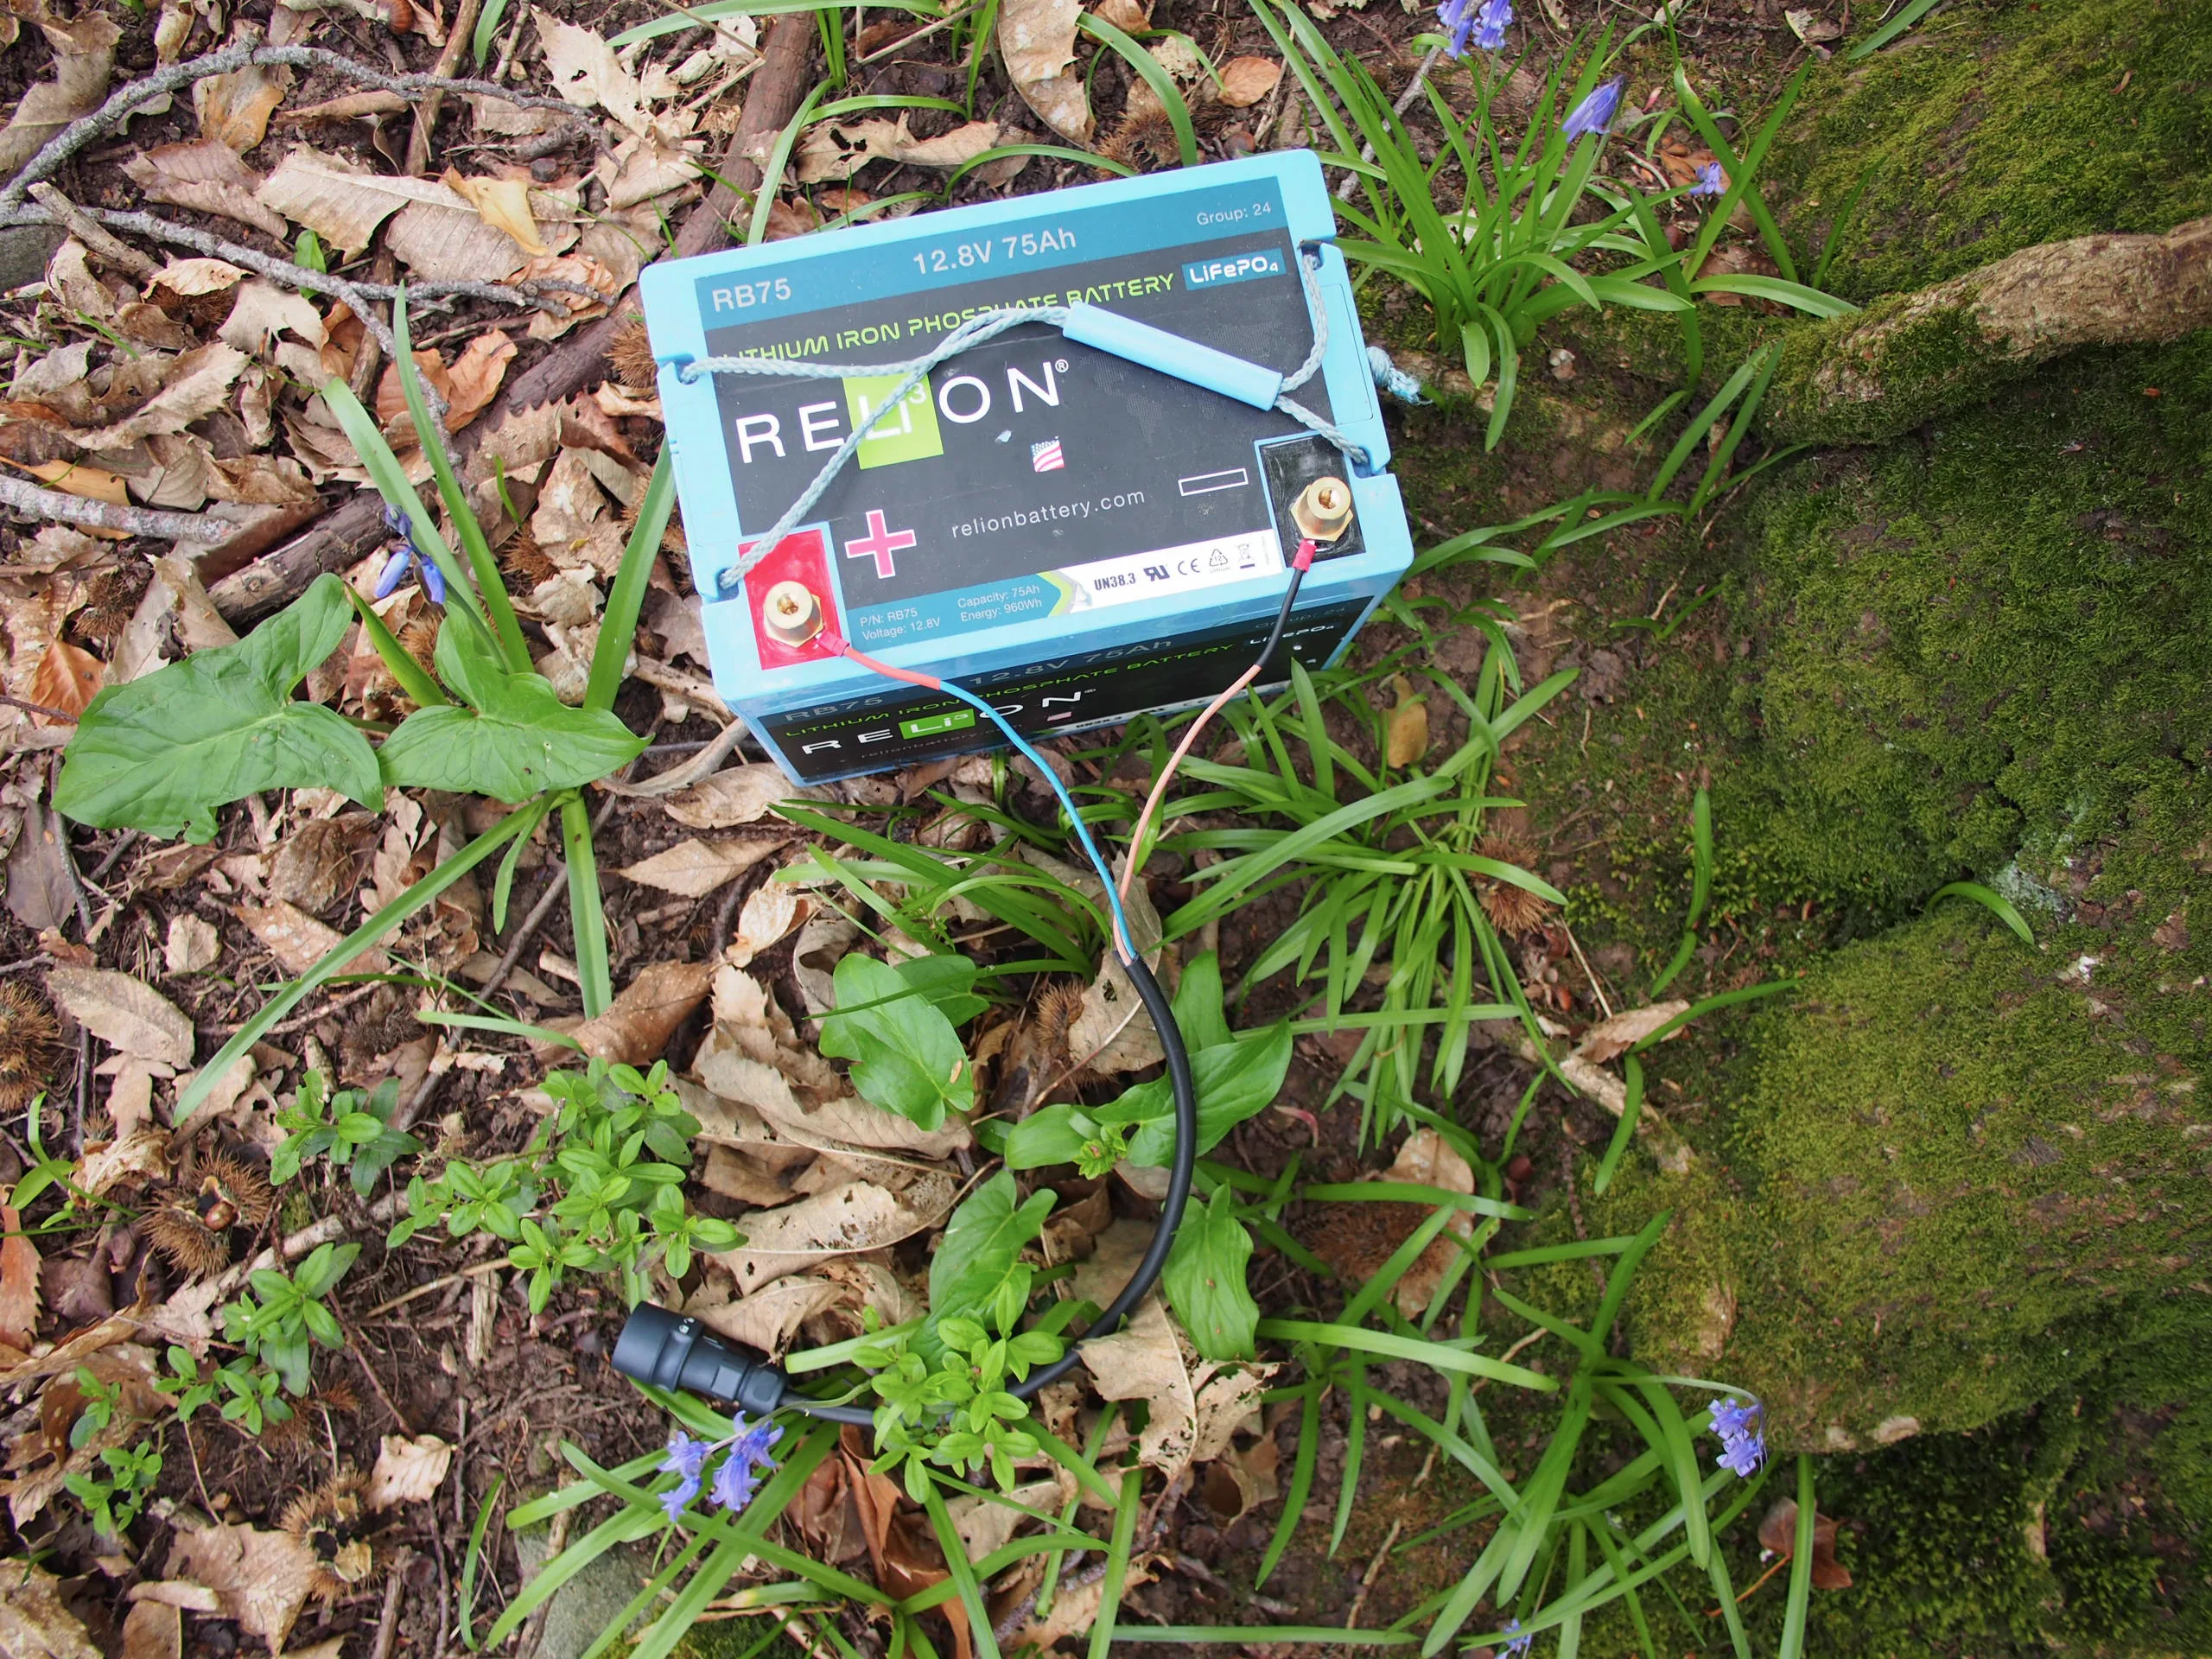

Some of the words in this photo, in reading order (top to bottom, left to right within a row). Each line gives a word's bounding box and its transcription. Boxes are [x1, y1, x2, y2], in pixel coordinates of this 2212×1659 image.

[1197, 208, 1248, 226] Group:
[1252, 202, 1272, 216] 24
[913, 240, 992, 275] 12.8V
[1001, 227, 1077, 258] 75Ah
[712, 277, 791, 312] RB75
[836, 321, 900, 350] IRON
[1066, 272, 1174, 305] BATTERY
[951, 491, 1146, 538] relionbattery.com
[1094, 572, 1137, 591] UN38.3
[1178, 558, 1201, 575] CE
[957, 591, 1009, 609] Capacity:
[1011, 584, 1040, 598] 75Ah
[860, 614, 885, 627] P/N:
[887, 607, 918, 622] RB75
[960, 607, 1002, 623] Energy:
[1004, 597, 1043, 614] 960Wh
[1255, 614, 1317, 629] Grup:
[862, 624, 906, 641] Voltage:
[910, 617, 940, 632] 12.8V
[1249, 626, 1334, 645] LiePO4
[969, 659, 1070, 685] 12.8V
[1083, 639, 1172, 664] 75Ah
[785, 712, 889, 736] LITHIUM
[899, 698, 961, 715] IRON
[1127, 644, 1234, 671] BATTERY
[785, 696, 883, 721] RB75
